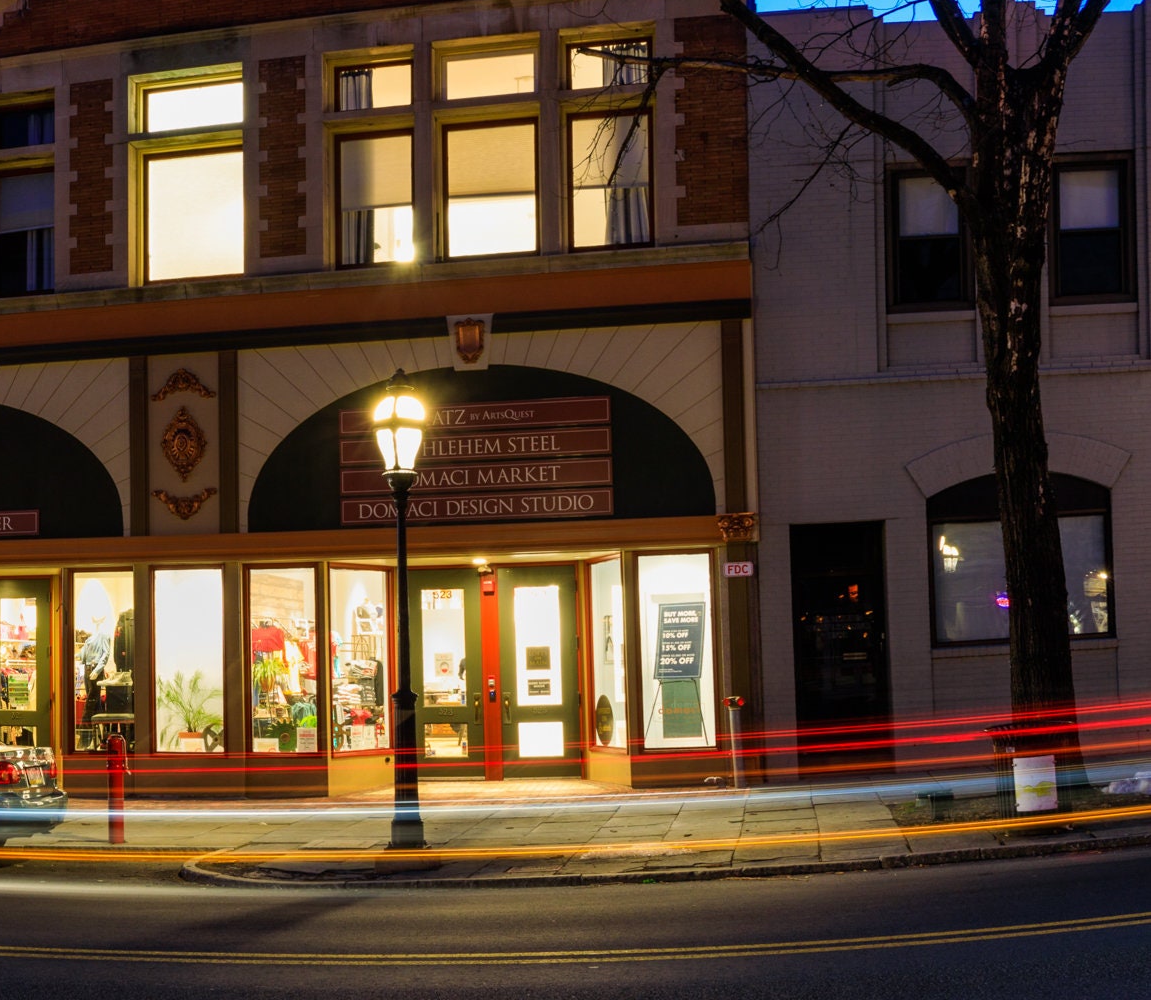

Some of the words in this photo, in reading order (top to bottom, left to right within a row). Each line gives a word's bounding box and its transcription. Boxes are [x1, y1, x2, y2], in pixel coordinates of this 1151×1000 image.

[432, 409, 466, 426] ATZ
[423, 437, 501, 457] HLEHEM
[507, 435, 561, 452] STEEL
[412, 469, 470, 488] MACI
[477, 465, 561, 484] MARKET
[446, 497, 513, 516] DESIGN
[521, 494, 595, 513] STUDIO
[727, 564, 749, 575] FDC
[661, 644, 676, 652] 15%
[659, 657, 678, 665] 20%
[678, 657, 694, 665] OFF
